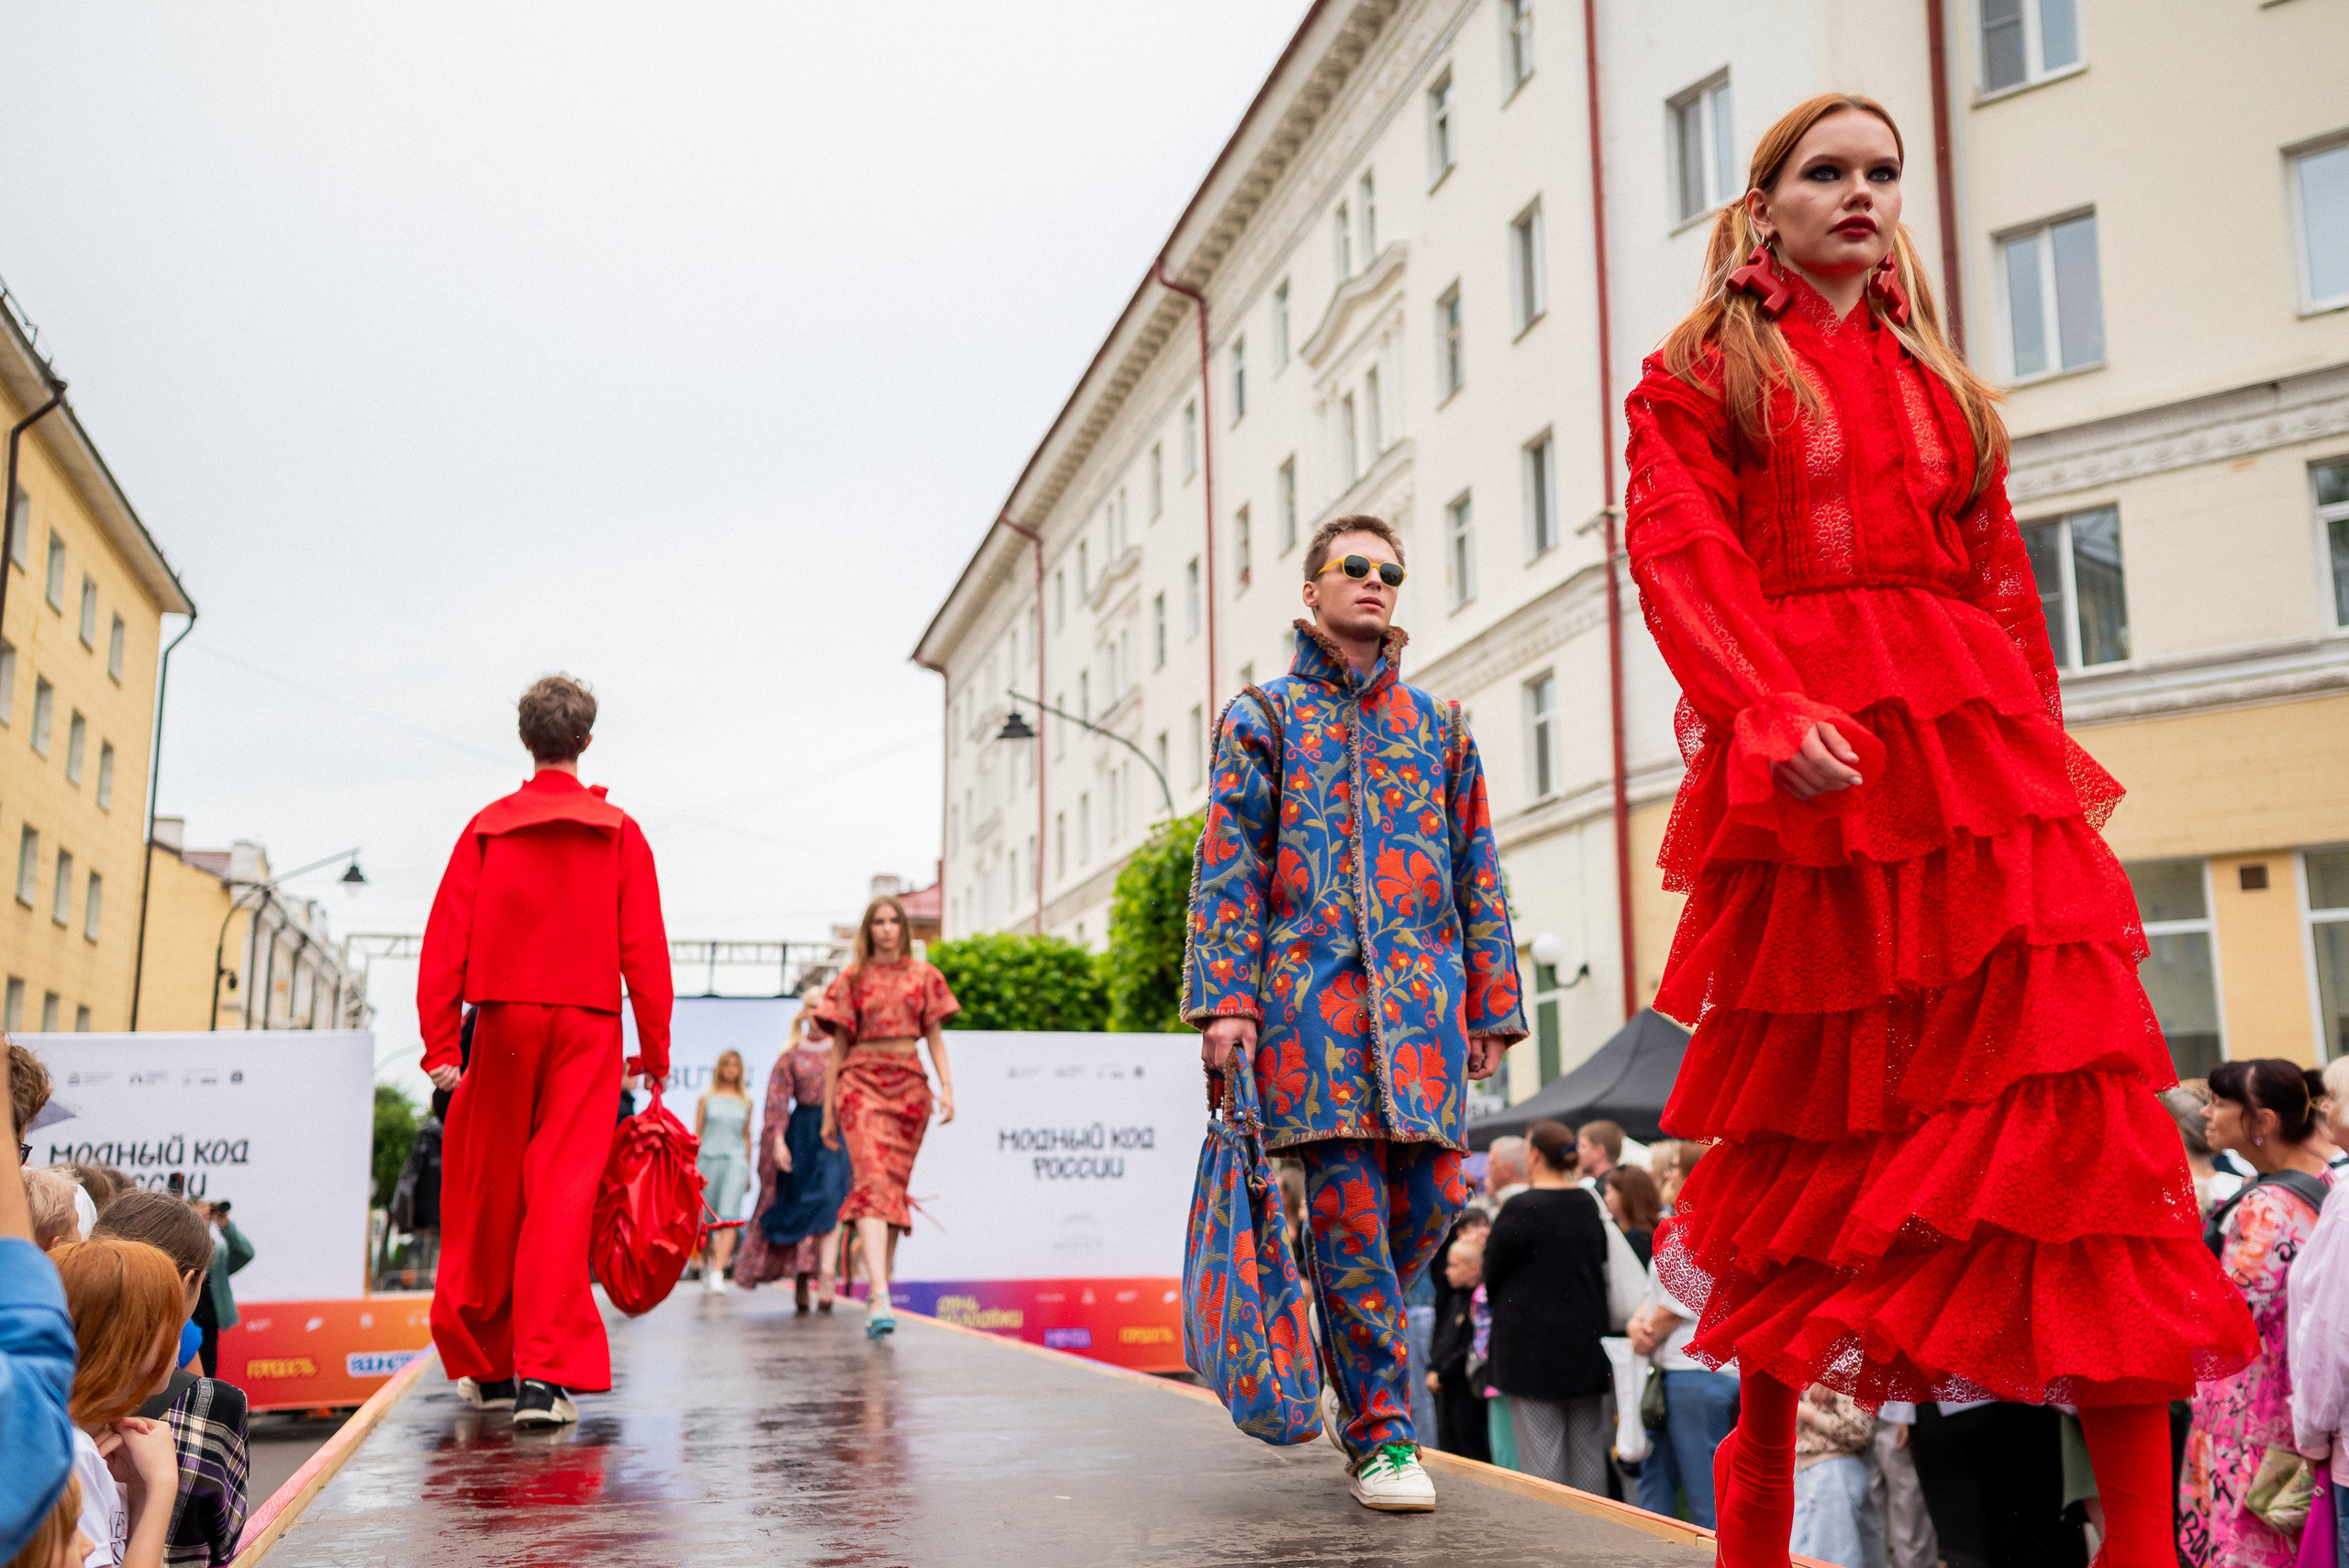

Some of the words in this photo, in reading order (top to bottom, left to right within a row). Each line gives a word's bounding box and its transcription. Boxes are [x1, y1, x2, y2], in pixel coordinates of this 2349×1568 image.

[50, 1133, 184, 1167] МОДНЫЙ
[194, 1139, 250, 1166] КОД
[998, 1122, 1104, 1151] МОДНЫЙ
[1111, 1126, 1154, 1151] КОД
[1033, 1156, 1124, 1179] РОССИИ
